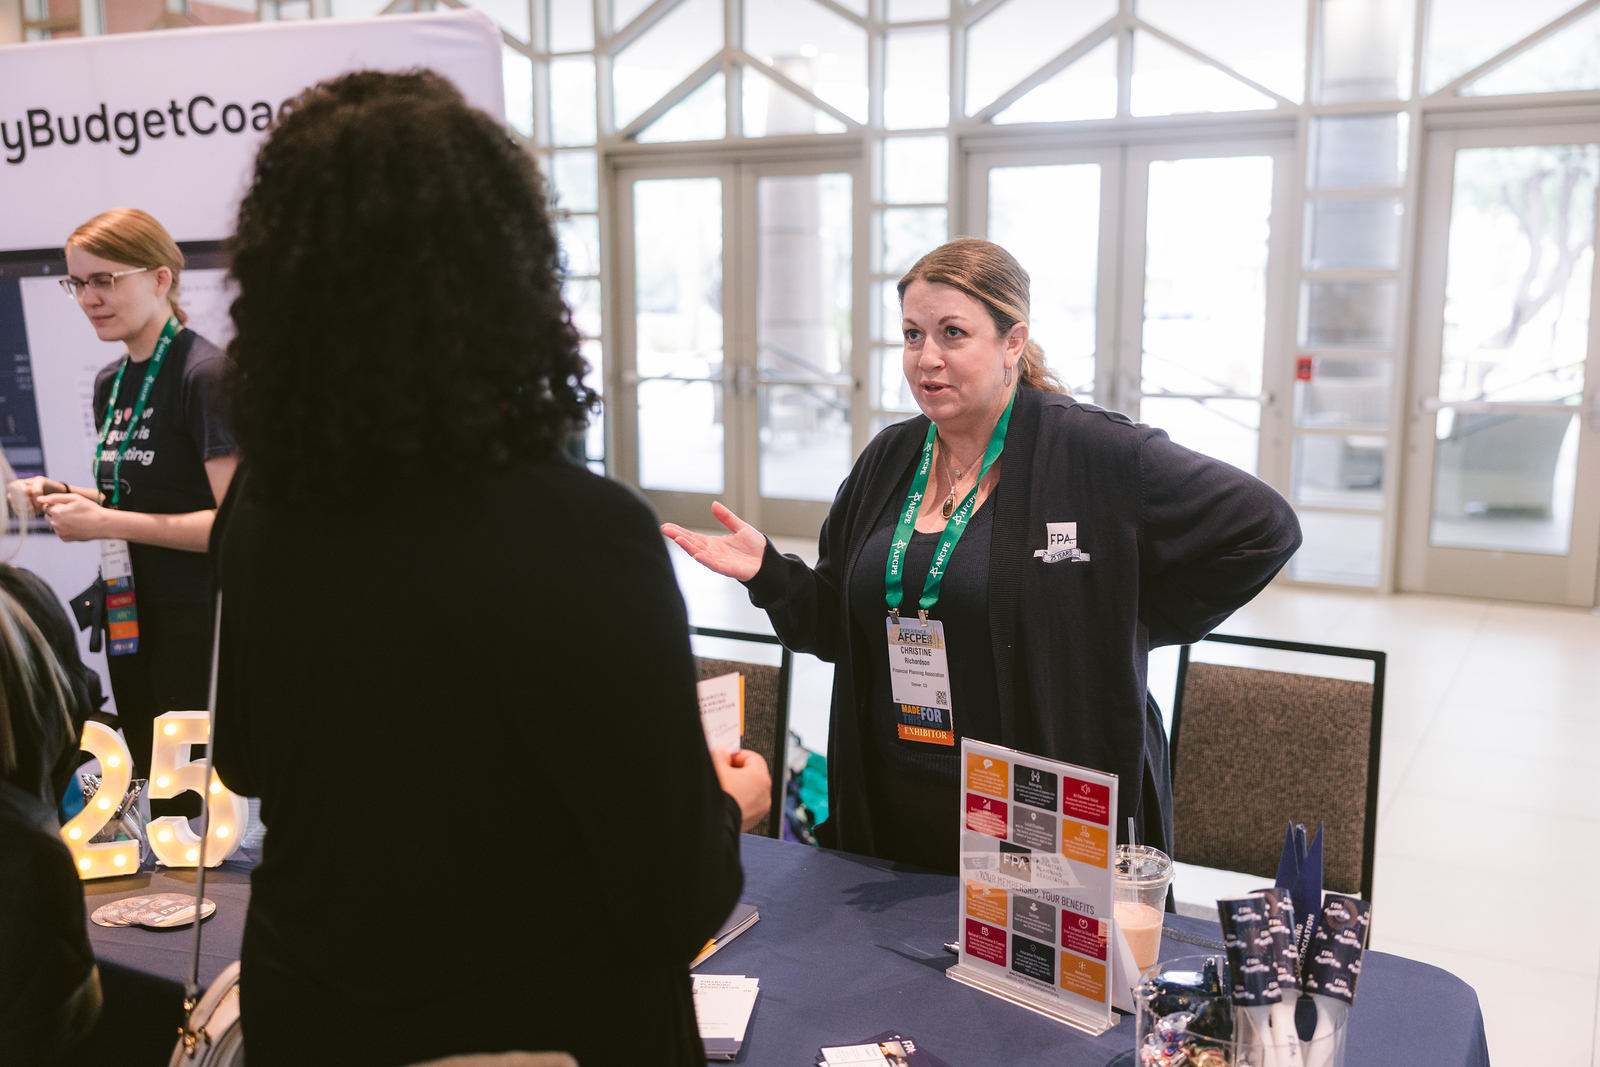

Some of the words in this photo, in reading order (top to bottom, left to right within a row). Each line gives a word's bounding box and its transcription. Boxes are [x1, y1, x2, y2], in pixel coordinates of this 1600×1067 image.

[904, 500, 918, 524] AFCPE
[1050, 533, 1071, 545] FPA
[890, 548, 901, 575] AFCPE
[936, 541, 952, 568] AFCPE
[898, 633, 927, 643] AFCPE
[901, 646, 932, 656] CHRISTINE
[905, 657, 930, 666] Richardson
[901, 704, 921, 715] MADE
[920, 707, 943, 723] FOR
[902, 713, 922, 726] THIS
[904, 726, 948, 739] EXHIBITOR
[1004, 853, 1027, 871] FPA
[1036, 872, 1070, 887] ASSOCIATION
[979, 871, 995, 884] YOUR
[1042, 891, 1060, 905] YOUR
[1062, 897, 1095, 916] BENEFITS
